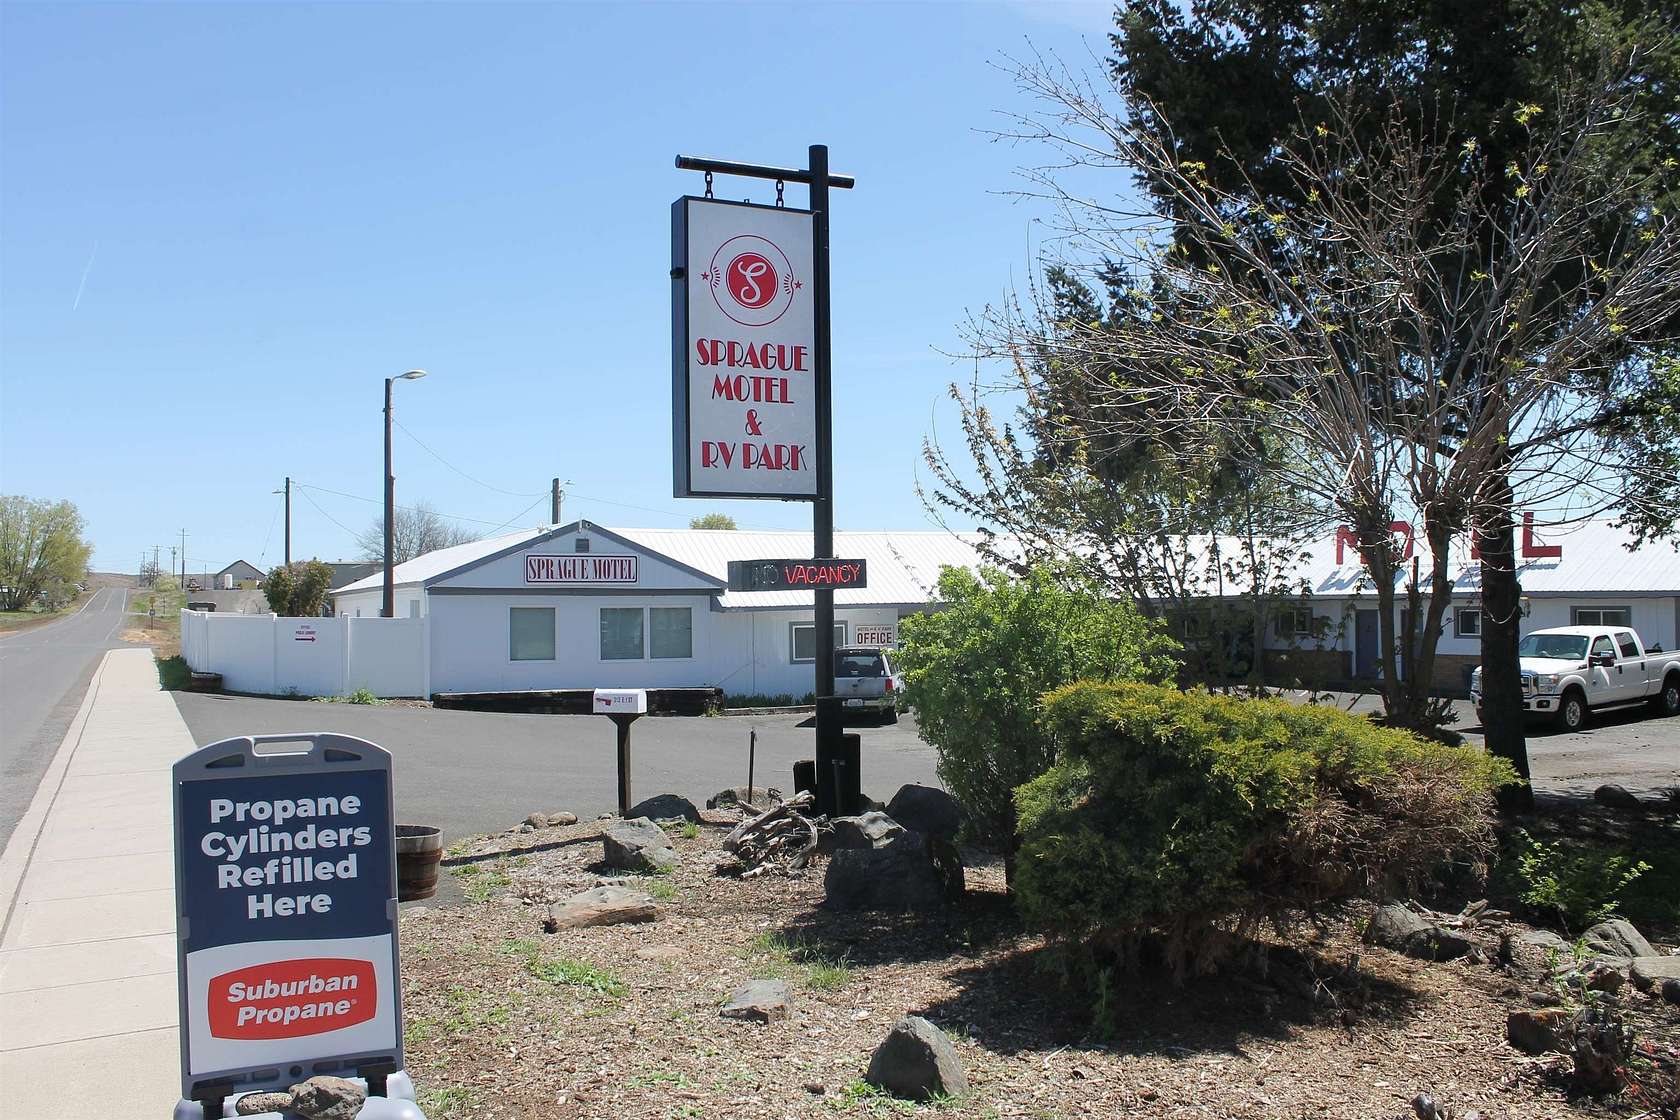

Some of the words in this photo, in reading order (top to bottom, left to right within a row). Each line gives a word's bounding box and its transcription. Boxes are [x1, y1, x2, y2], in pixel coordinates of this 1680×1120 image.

[737, 261, 767, 304] S
[696, 338, 809, 371] SPRAGUE
[712, 374, 794, 404] MOTEL
[745, 409, 762, 436] &
[702, 441, 736, 470] RV
[742, 443, 807, 471] PARK
[528, 558, 588, 580] SPRAGUE
[592, 559, 635, 580] MOTEL
[784, 563, 860, 584] VACANCY
[857, 632, 892, 644] OFFICE
[210, 795, 361, 825] Propane
[201, 824, 372, 862] Cylinders
[217, 853, 358, 889] Refilled
[247, 893, 332, 919] Here
[227, 974, 358, 1003] Suburban
